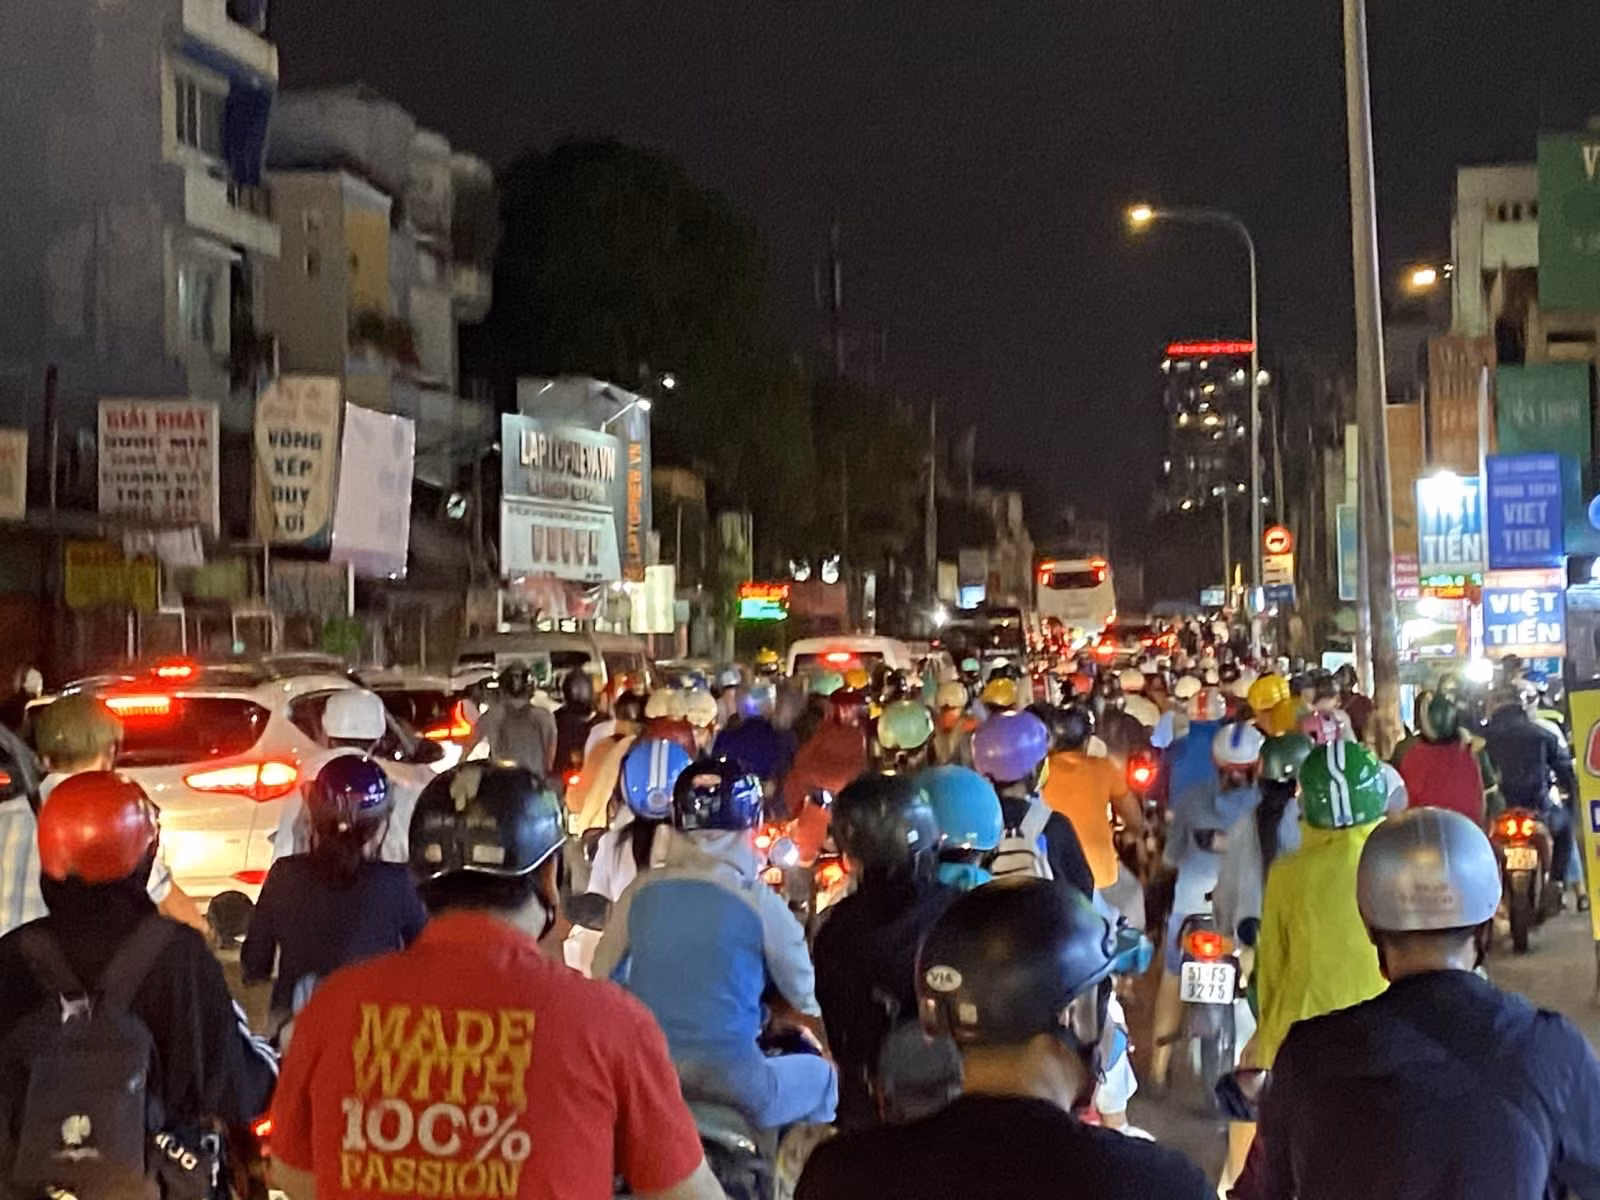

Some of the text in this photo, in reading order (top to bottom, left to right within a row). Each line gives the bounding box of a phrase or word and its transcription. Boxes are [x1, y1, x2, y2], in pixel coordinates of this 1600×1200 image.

[1488, 589, 1559, 617] VIỆT
[1487, 617, 1561, 645] TIẾN
[353, 1001, 536, 1060] MADE
[353, 1045, 530, 1113] WITH
[340, 1151, 523, 1199] PASSION
